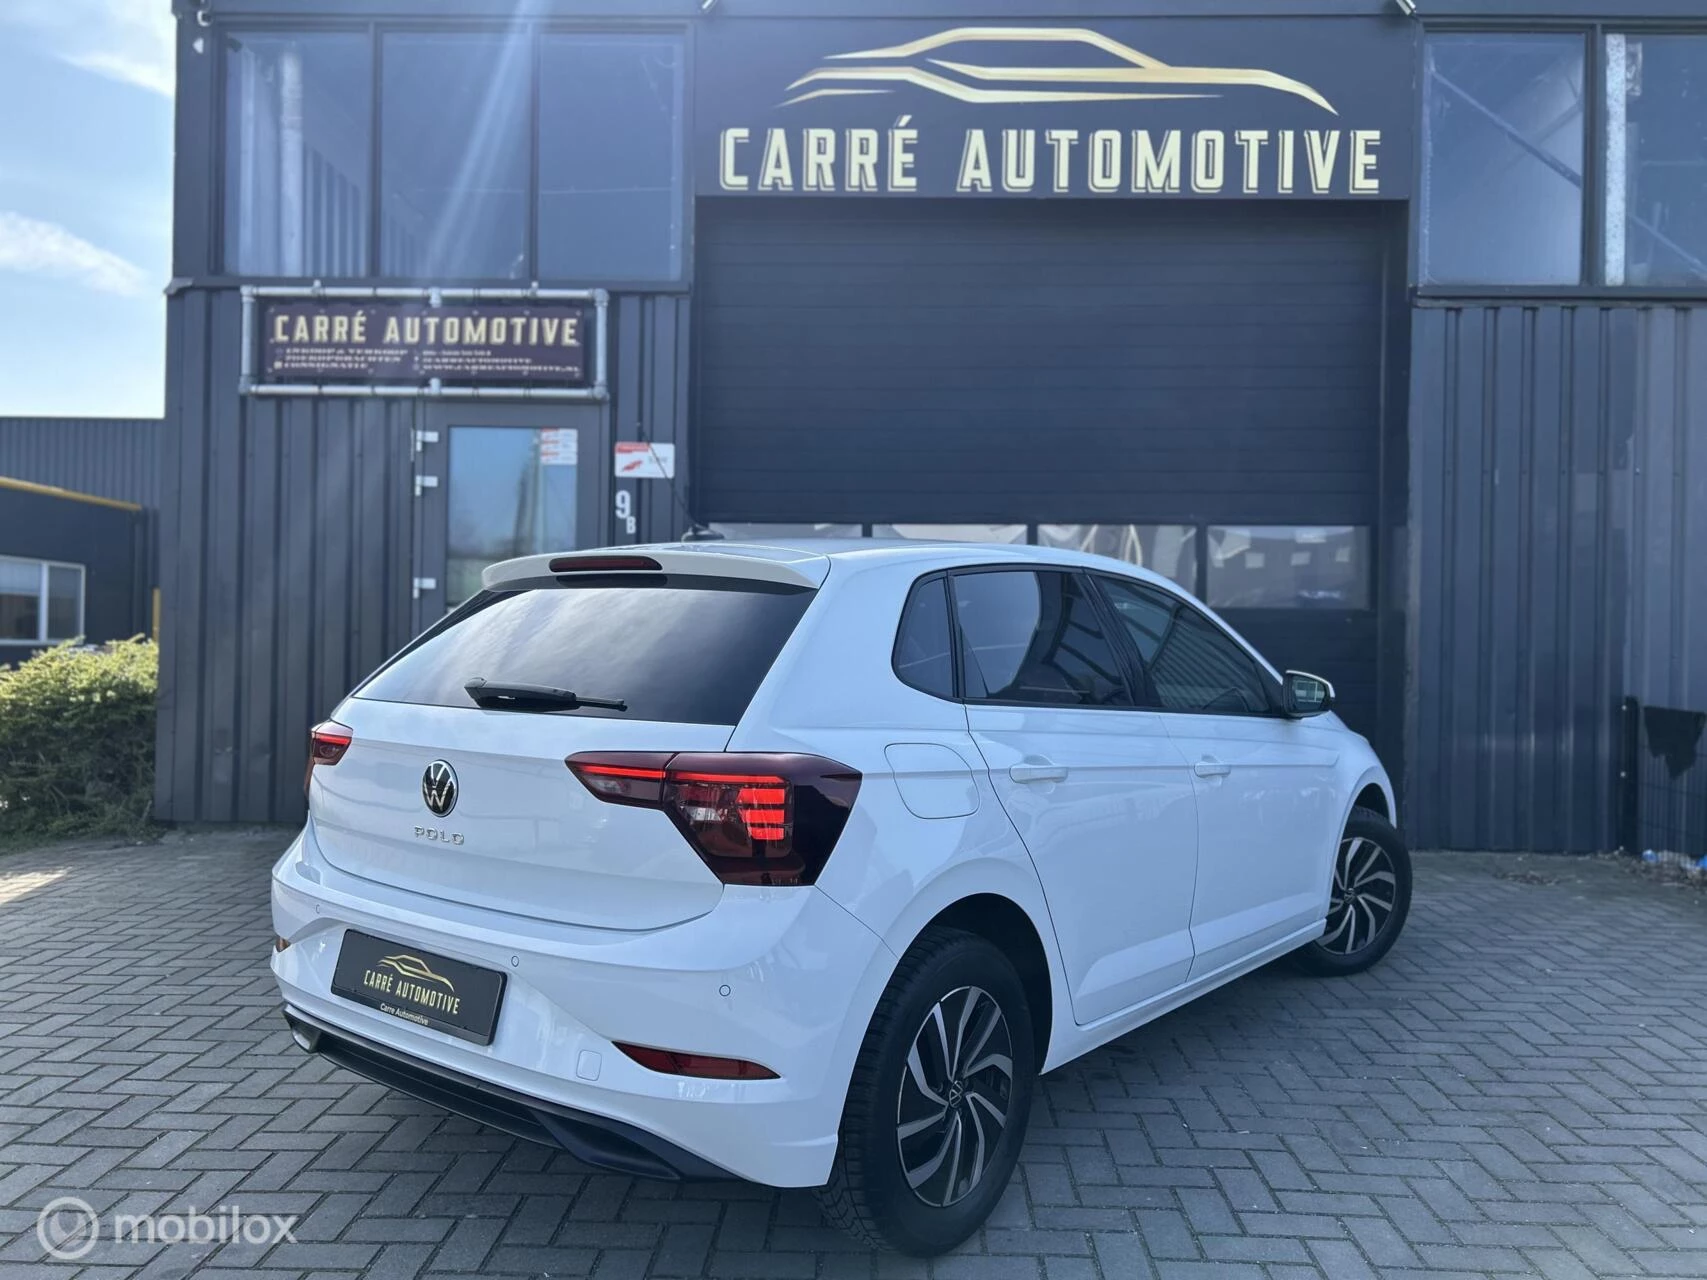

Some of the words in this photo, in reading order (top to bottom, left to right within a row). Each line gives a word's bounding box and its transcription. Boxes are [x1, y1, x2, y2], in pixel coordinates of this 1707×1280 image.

[719, 115, 918, 192] CARRÉ
[956, 129, 1381, 195] AUTOMOTIVE
[274, 310, 367, 343] CARRÉ
[383, 316, 579, 346] AUTOMOTIVE
[414, 825, 465, 846] POLO
[363, 969, 394, 993] CARRÉ
[395, 980, 460, 1015] AUTOMOTIVE
[395, 1008, 429, 1026] Automotive
